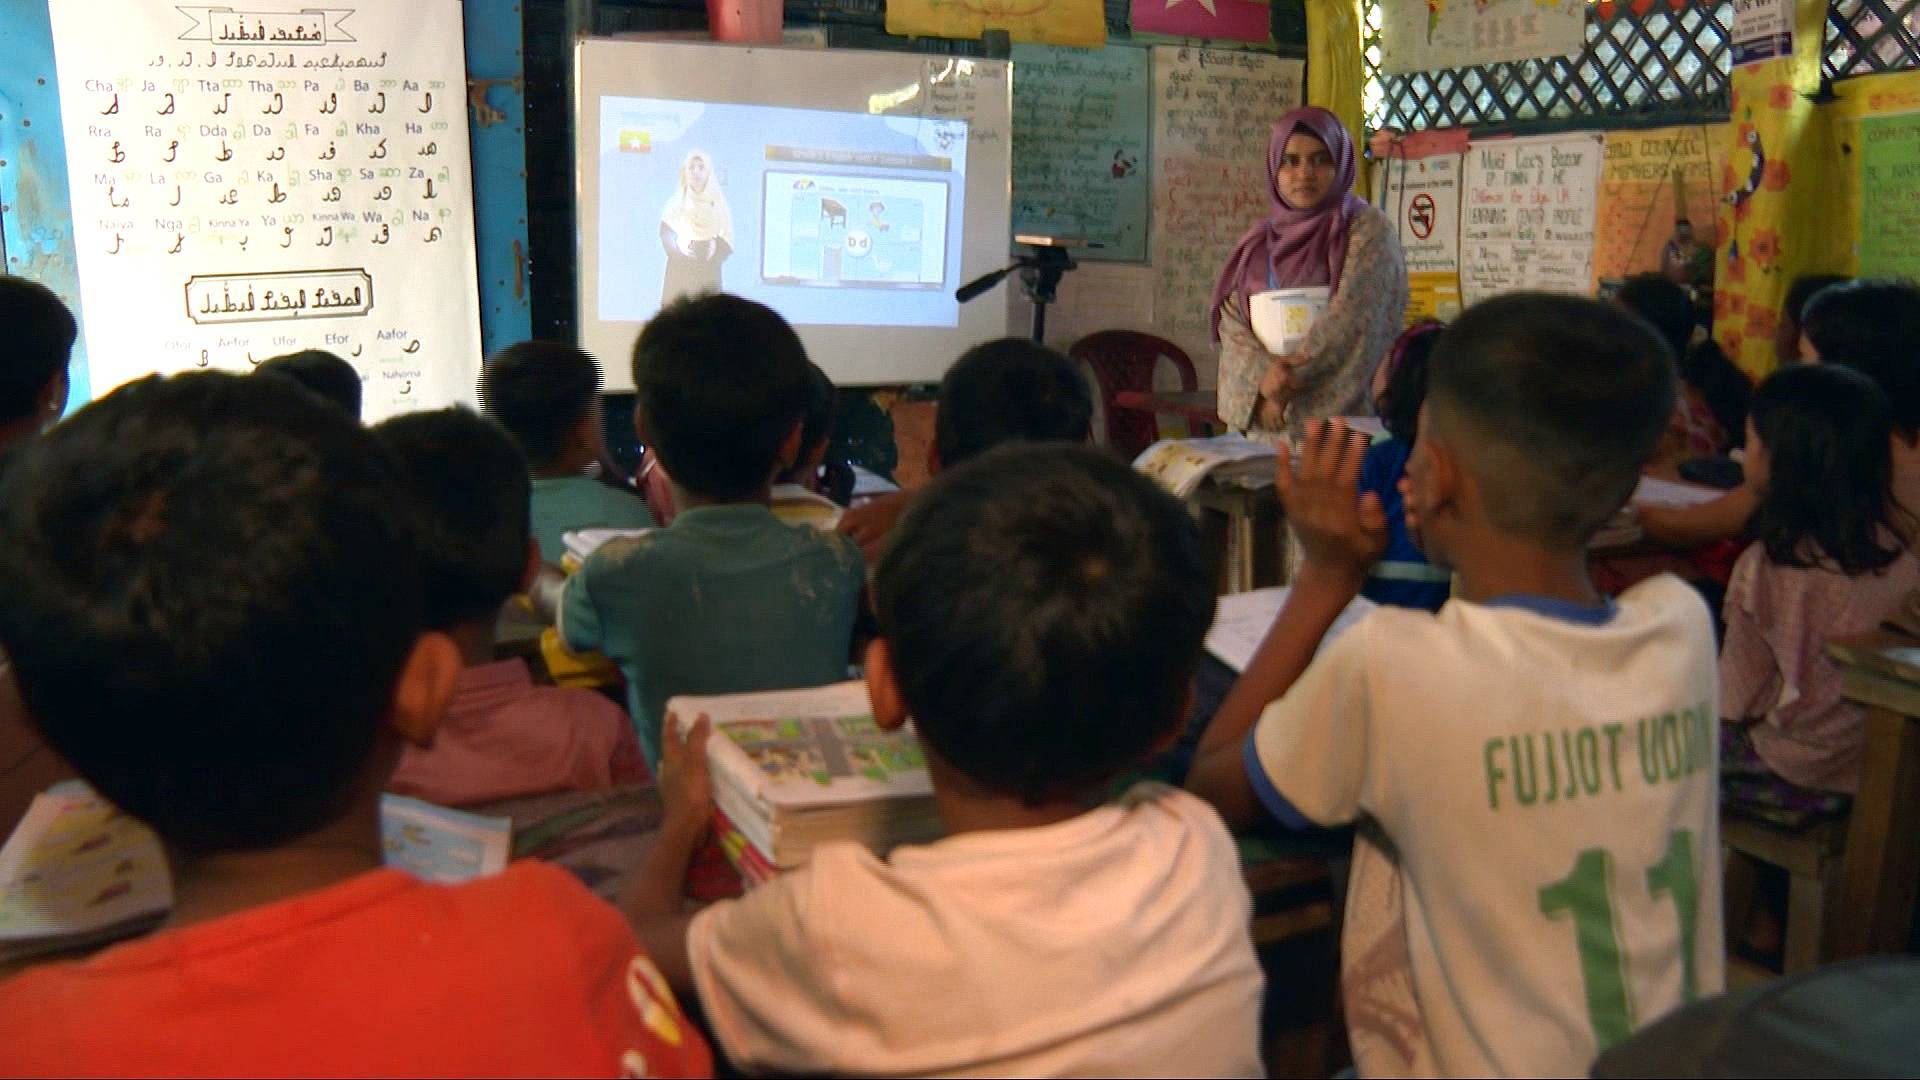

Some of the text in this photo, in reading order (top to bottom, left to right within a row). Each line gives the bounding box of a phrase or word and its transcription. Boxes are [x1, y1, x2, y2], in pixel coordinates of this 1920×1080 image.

[85, 80, 419, 92] Cha Ja Tta Tha Pa Ba Aa
[145, 125, 162, 137] Ra
[200, 124, 227, 137] Dda
[253, 125, 271, 136] Da
[305, 124, 319, 135] Fa
[356, 123, 380, 135] Kha
[405, 123, 422, 134] Ha
[150, 173, 165, 184] La
[204, 172, 222, 183] Ga
[257, 171, 273, 182] Ka
[309, 169, 332, 181] Sha
[360, 168, 374, 180] Sa
[408, 167, 424, 178] Za
[155, 219, 183, 232] Nga
[261, 215, 276, 226] Ya
[363, 212, 382, 223] Wa
[412, 210, 430, 221] Na
[325, 334, 349, 345] Efor
[377, 329, 408, 340] Aafor
[1538, 828, 1698, 1053] 11
